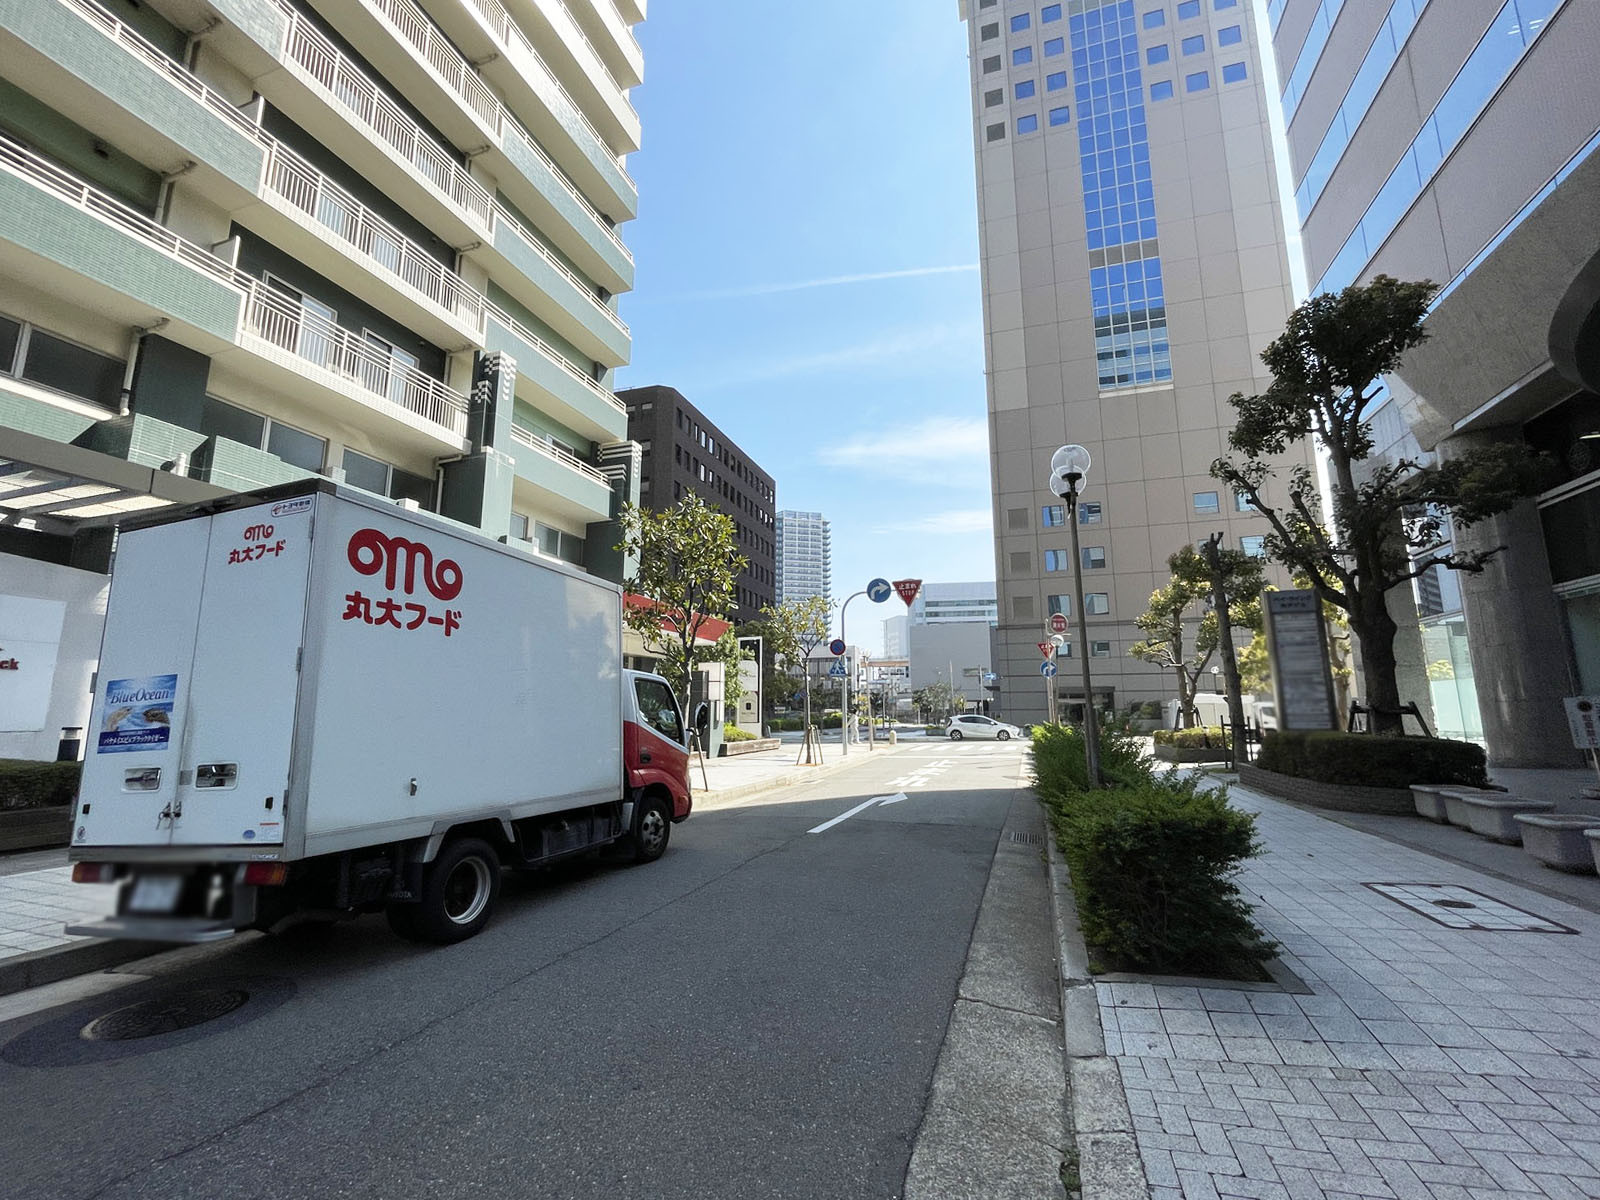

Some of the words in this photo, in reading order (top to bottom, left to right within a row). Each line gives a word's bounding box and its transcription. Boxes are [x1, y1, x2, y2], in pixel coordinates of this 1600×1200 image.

[228, 539, 287, 565] 丸大フード
[342, 590, 462, 637] 丸大フード
